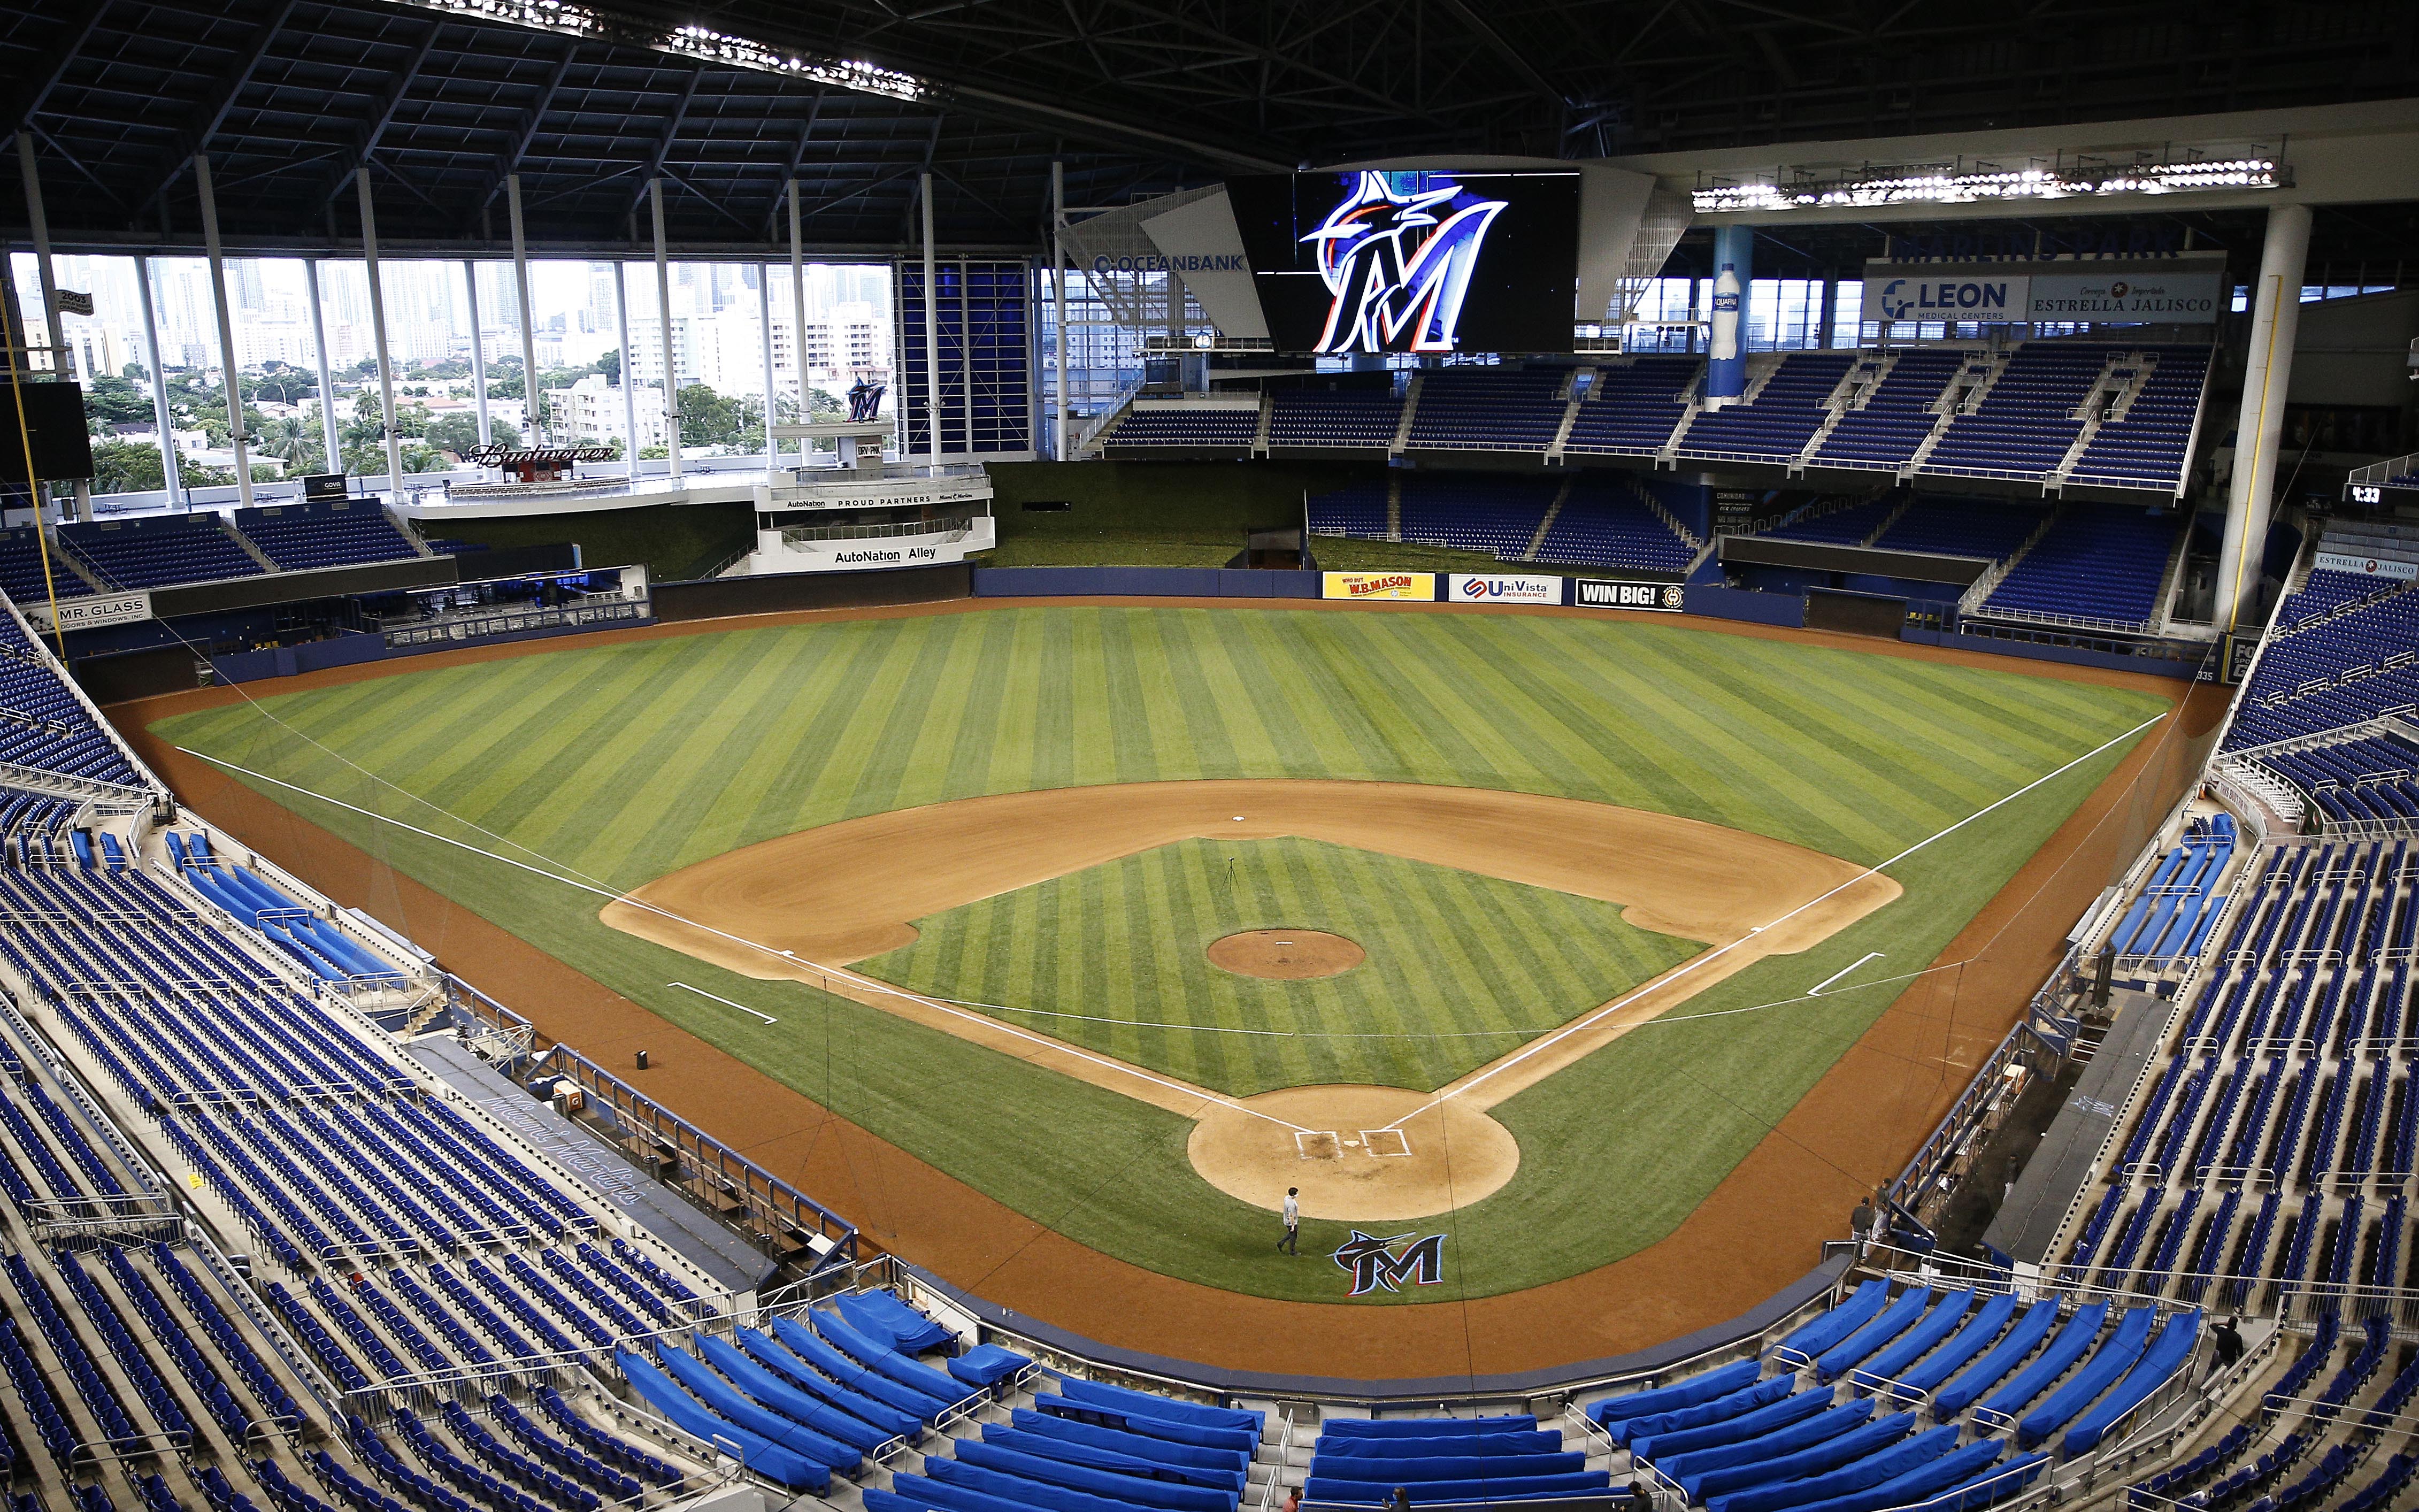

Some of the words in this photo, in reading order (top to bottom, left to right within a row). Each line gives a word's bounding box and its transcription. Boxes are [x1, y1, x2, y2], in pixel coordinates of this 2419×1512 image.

[1892, 232, 2059, 263] MARLINS
[2074, 230, 2179, 260] PARK
[1117, 256, 1244, 272] OCEANBANK
[62, 291, 86, 303] 2003
[1919, 283, 2006, 308] LEON
[2034, 299, 2124, 312] ESTRELLA
[2131, 298, 2211, 312] JALISCO
[1197, 334, 1210, 346] 42
[469, 442, 615, 469] Budweiser
[880, 496, 931, 504] PARTNERS
[2353, 486, 2380, 503] 4:33
[835, 550, 900, 563] AutoNation
[908, 547, 936, 559] Alley
[2320, 556, 2364, 569] ESTRELLA
[2378, 564, 2414, 575] JALISCO
[1488, 581, 1547, 596] UniVista
[1582, 584, 1617, 603] WIN
[1619, 586, 1656, 605] BIG!
[59, 608, 88, 620] MR.
[91, 600, 143, 615] GLASS
[2236, 644, 2256, 658] FO
[2197, 671, 2213, 681] 335
[2233, 664, 2248, 678] G
[479, 1094, 570, 1143] Miami
[541, 1140, 646, 1206] Marlins
